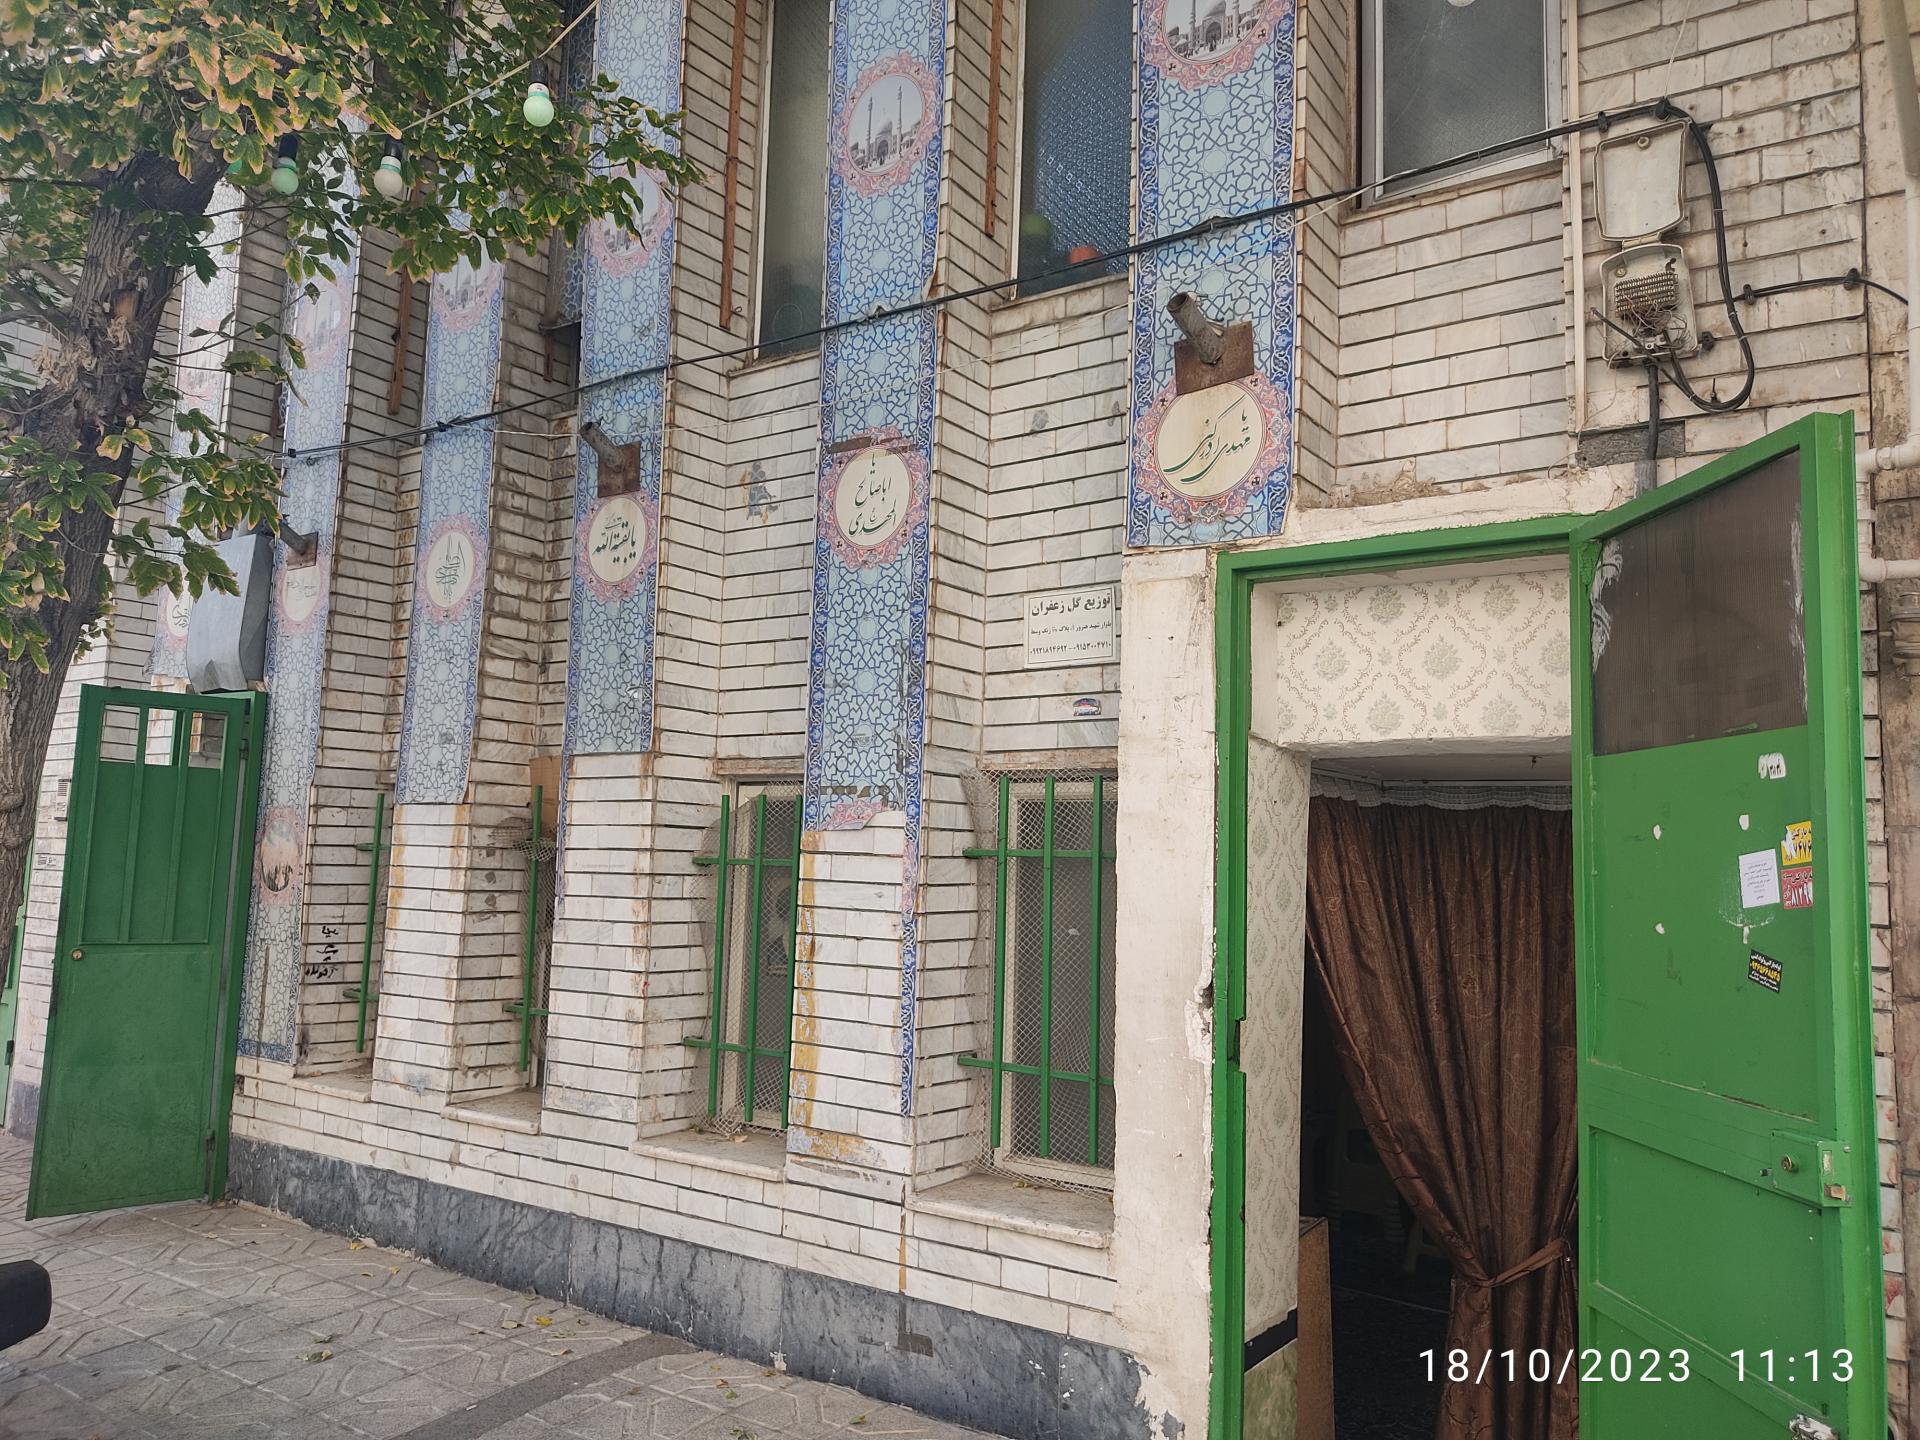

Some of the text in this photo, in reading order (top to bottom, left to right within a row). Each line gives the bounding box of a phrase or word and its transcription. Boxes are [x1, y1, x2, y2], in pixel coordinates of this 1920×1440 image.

[1031, 593, 1111, 616] توزیع گل زعفران
